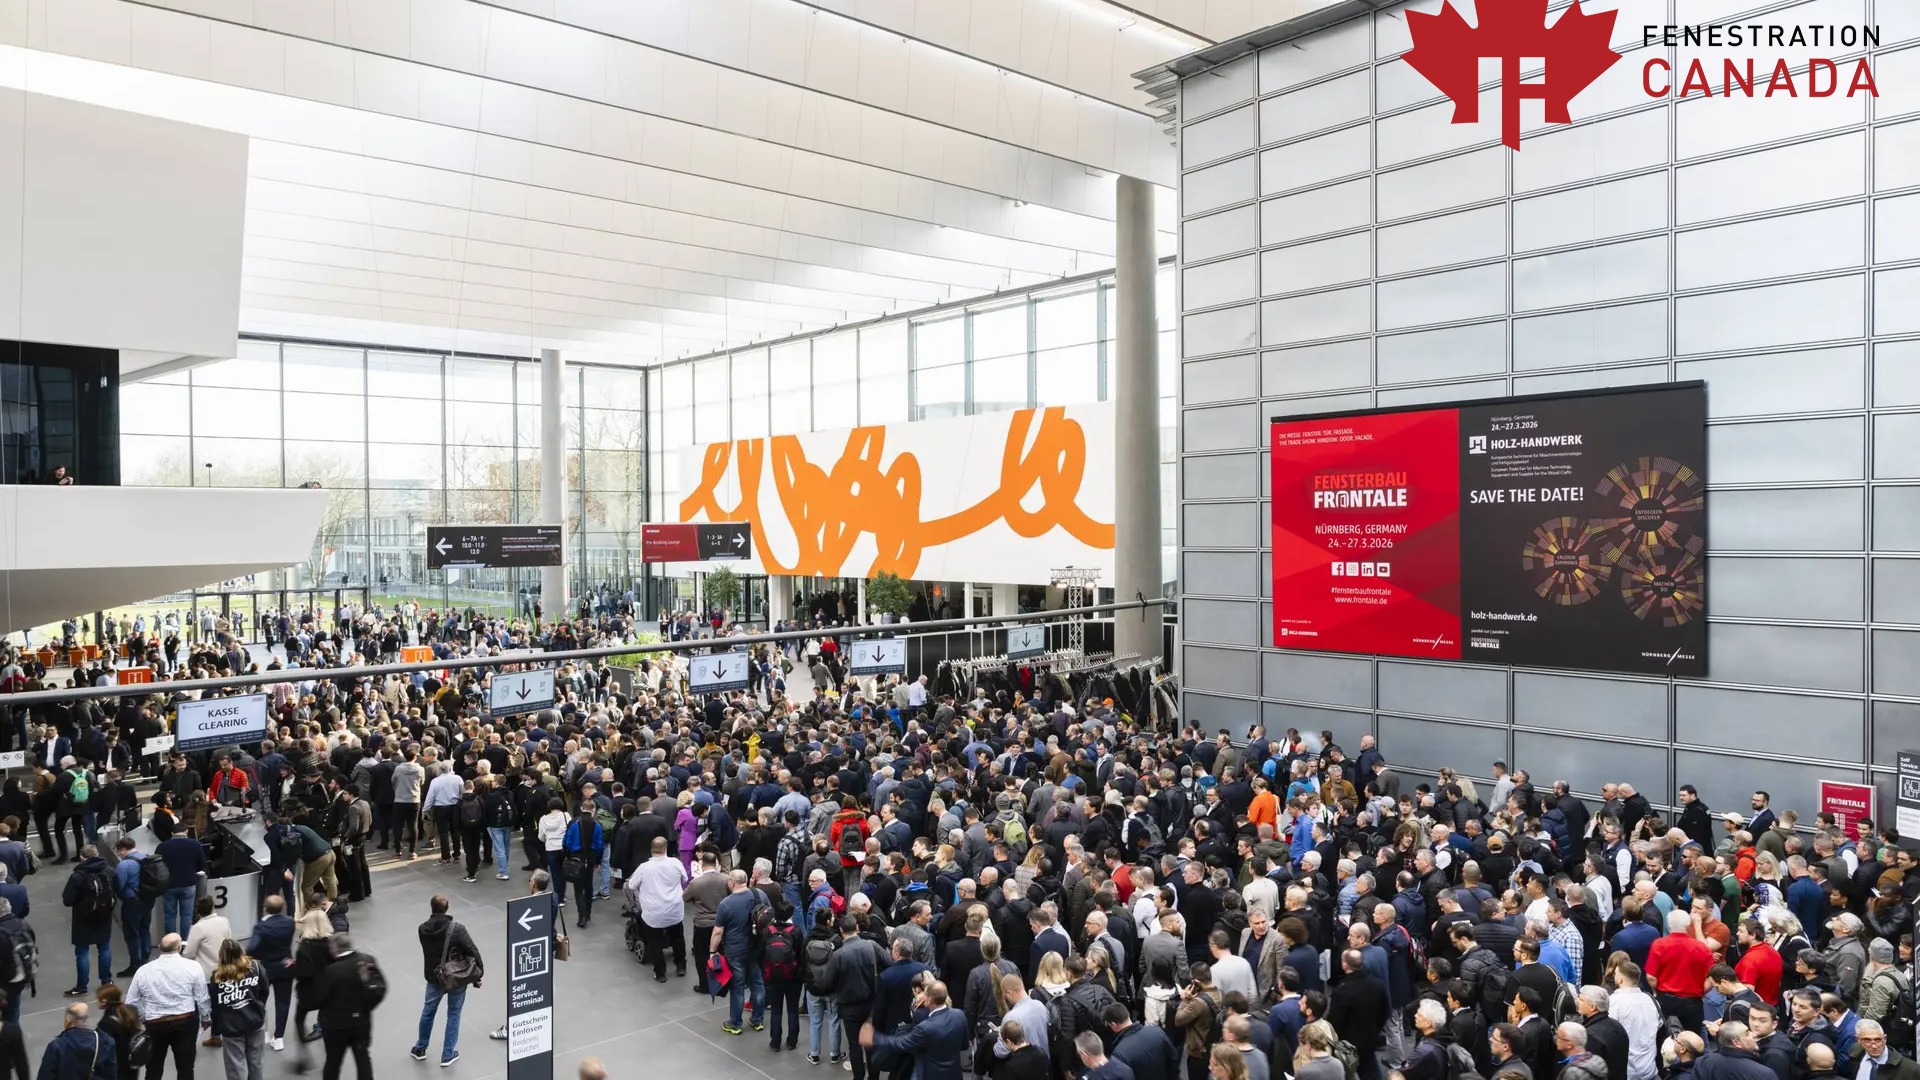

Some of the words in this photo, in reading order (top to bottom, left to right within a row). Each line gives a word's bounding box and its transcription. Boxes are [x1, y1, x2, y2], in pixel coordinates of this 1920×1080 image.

[1491, 434, 1582, 450] HOLZ-HANDWERK
[1314, 472, 1407, 490] FENSTERBAU
[1314, 488, 1407, 508] FRONTALE
[1470, 490, 1504, 504] SAVE
[1509, 488, 1536, 502] THE
[1541, 486, 1584, 502] DATE!
[1315, 524, 1363, 536] NÜRNBERG,
[1365, 524, 1408, 534] GERMANY
[1331, 586, 1392, 596] #fensterbaufrontale
[1334, 596, 1388, 605] www.frontale.de
[1471, 611, 1538, 622] holz-handwerk.de
[208, 707, 239, 717] KASSE
[198, 718, 248, 730] CLEARING
[1827, 797, 1866, 808] FRONTALE
[214, 886, 228, 908] 3
[512, 983, 526, 993] Self
[512, 990, 538, 1001] Service
[512, 995, 544, 1008] Terminal
[513, 1014, 548, 1029] Gutschein
[513, 1035, 539, 1046] Redeem
[513, 1044, 540, 1055] Voucher
